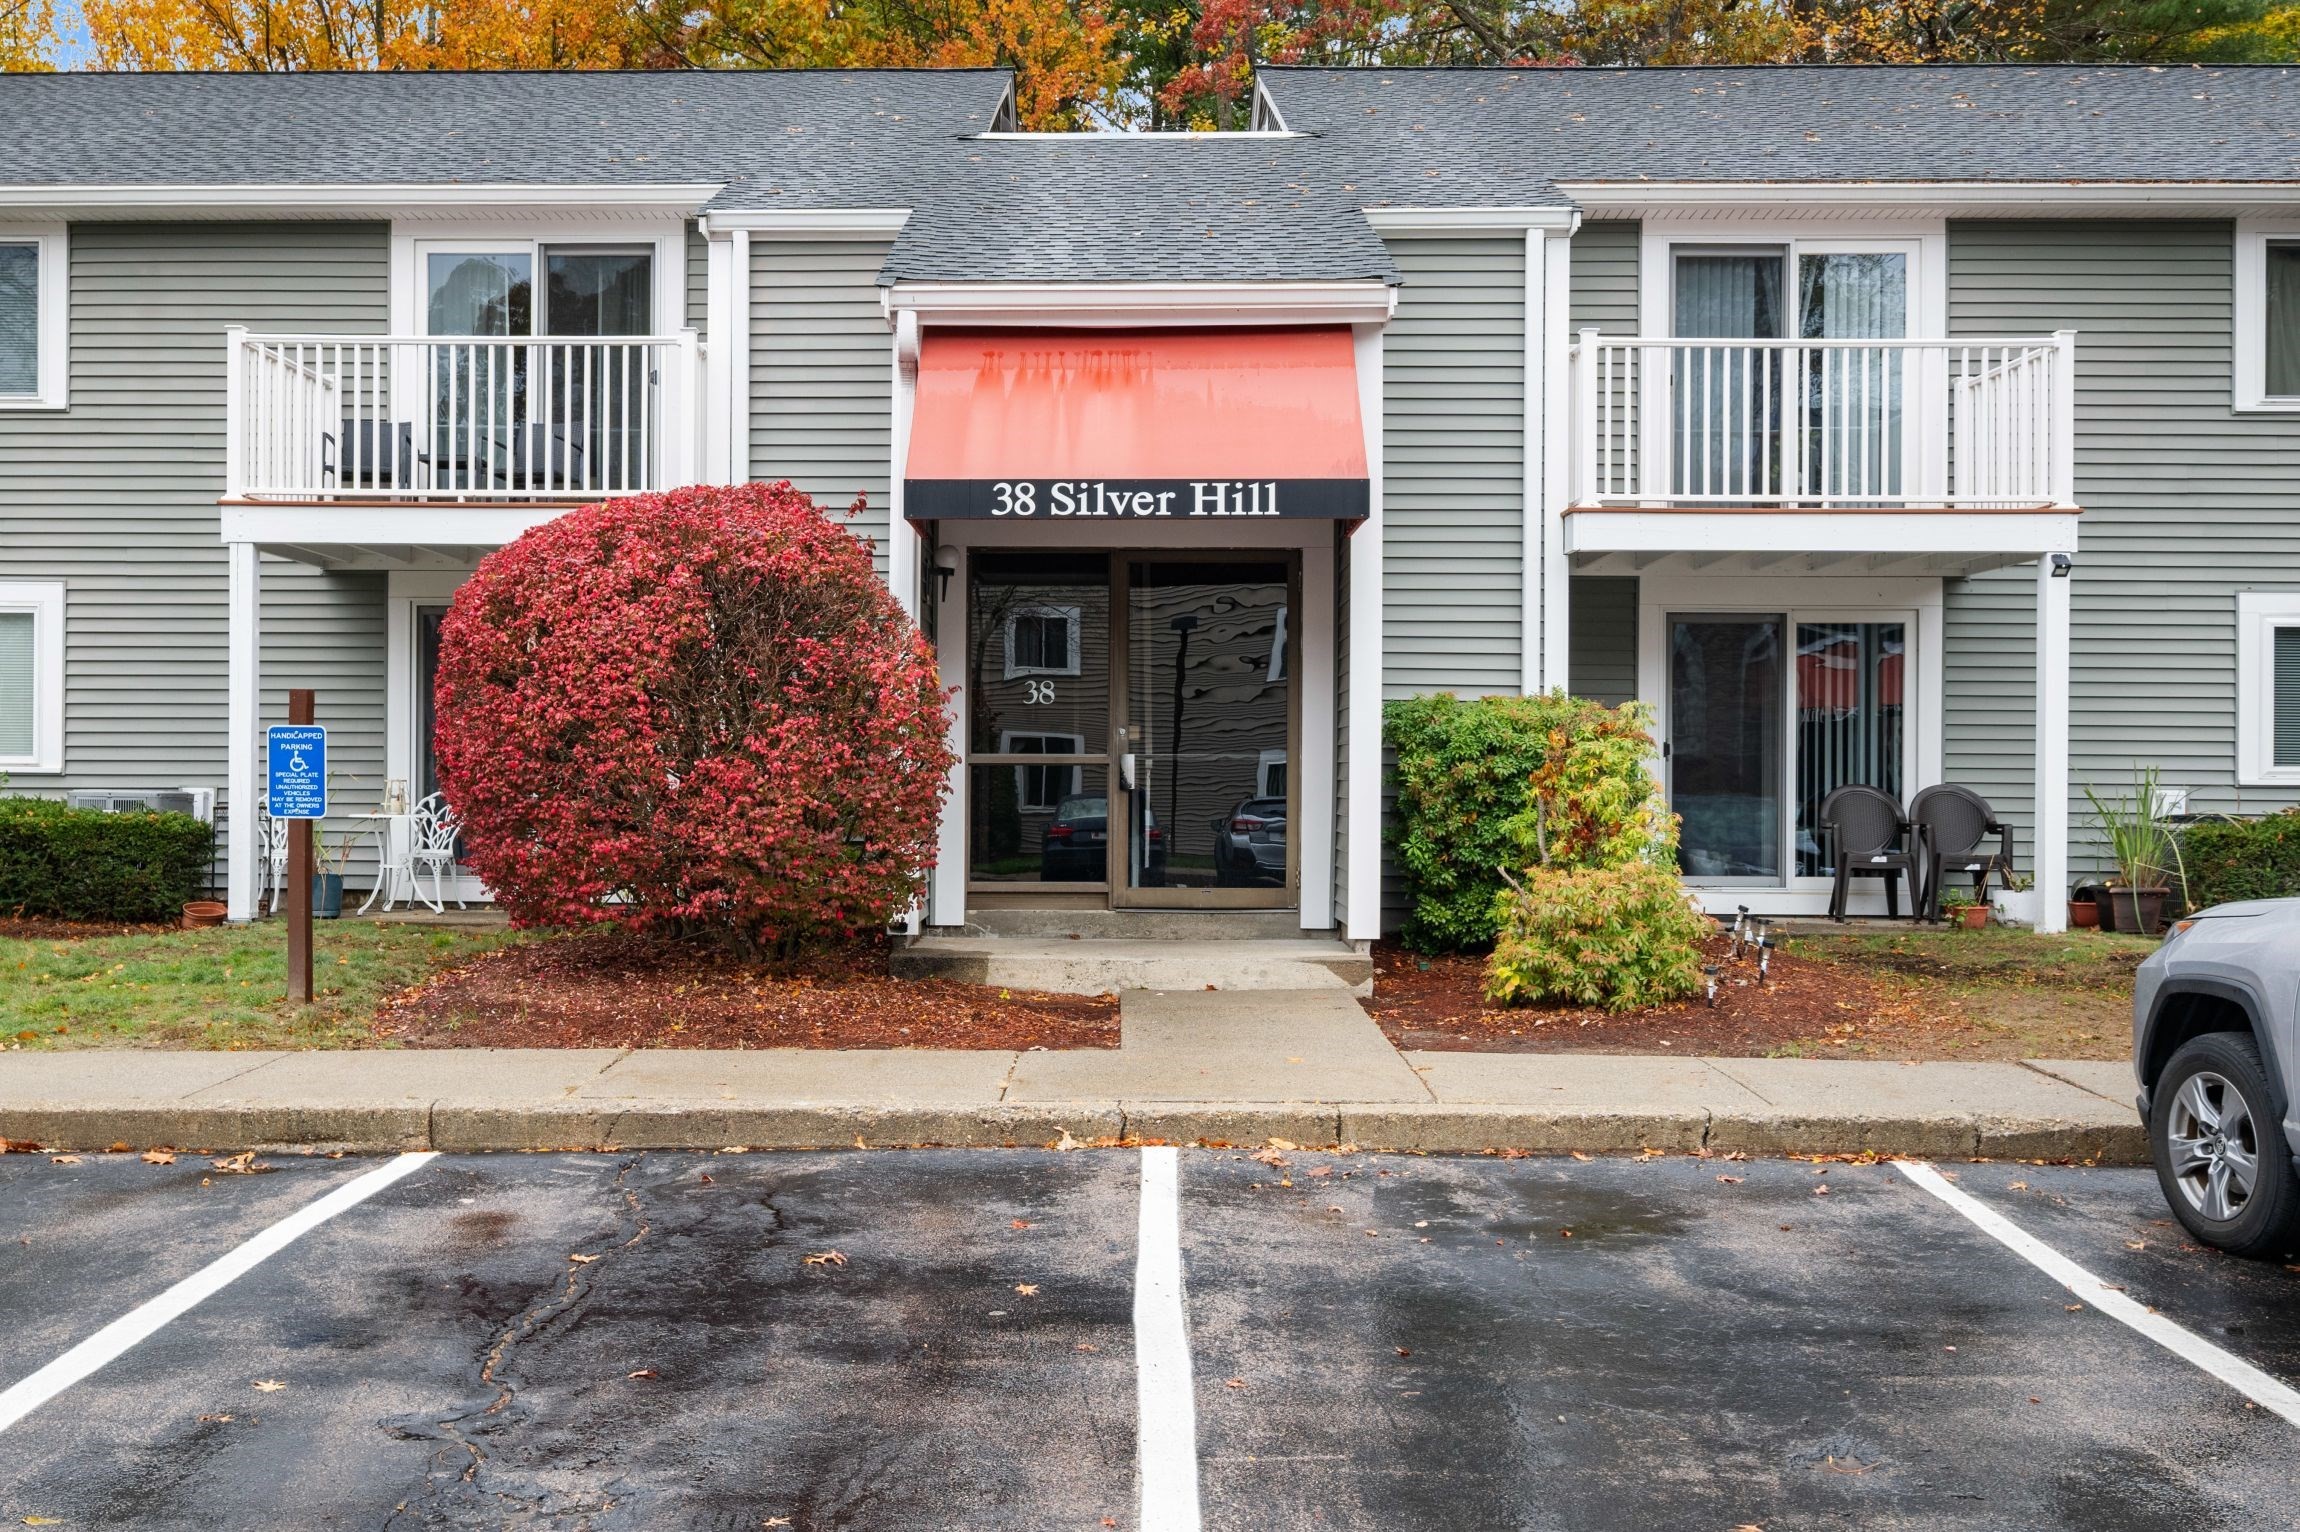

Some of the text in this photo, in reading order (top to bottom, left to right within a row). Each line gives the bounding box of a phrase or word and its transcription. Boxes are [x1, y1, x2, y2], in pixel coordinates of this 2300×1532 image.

[991, 482, 1280, 516] 38 Silver Hill
[1023, 680, 1055, 705] 38
[270, 732, 323, 740] HANDICAPPED
